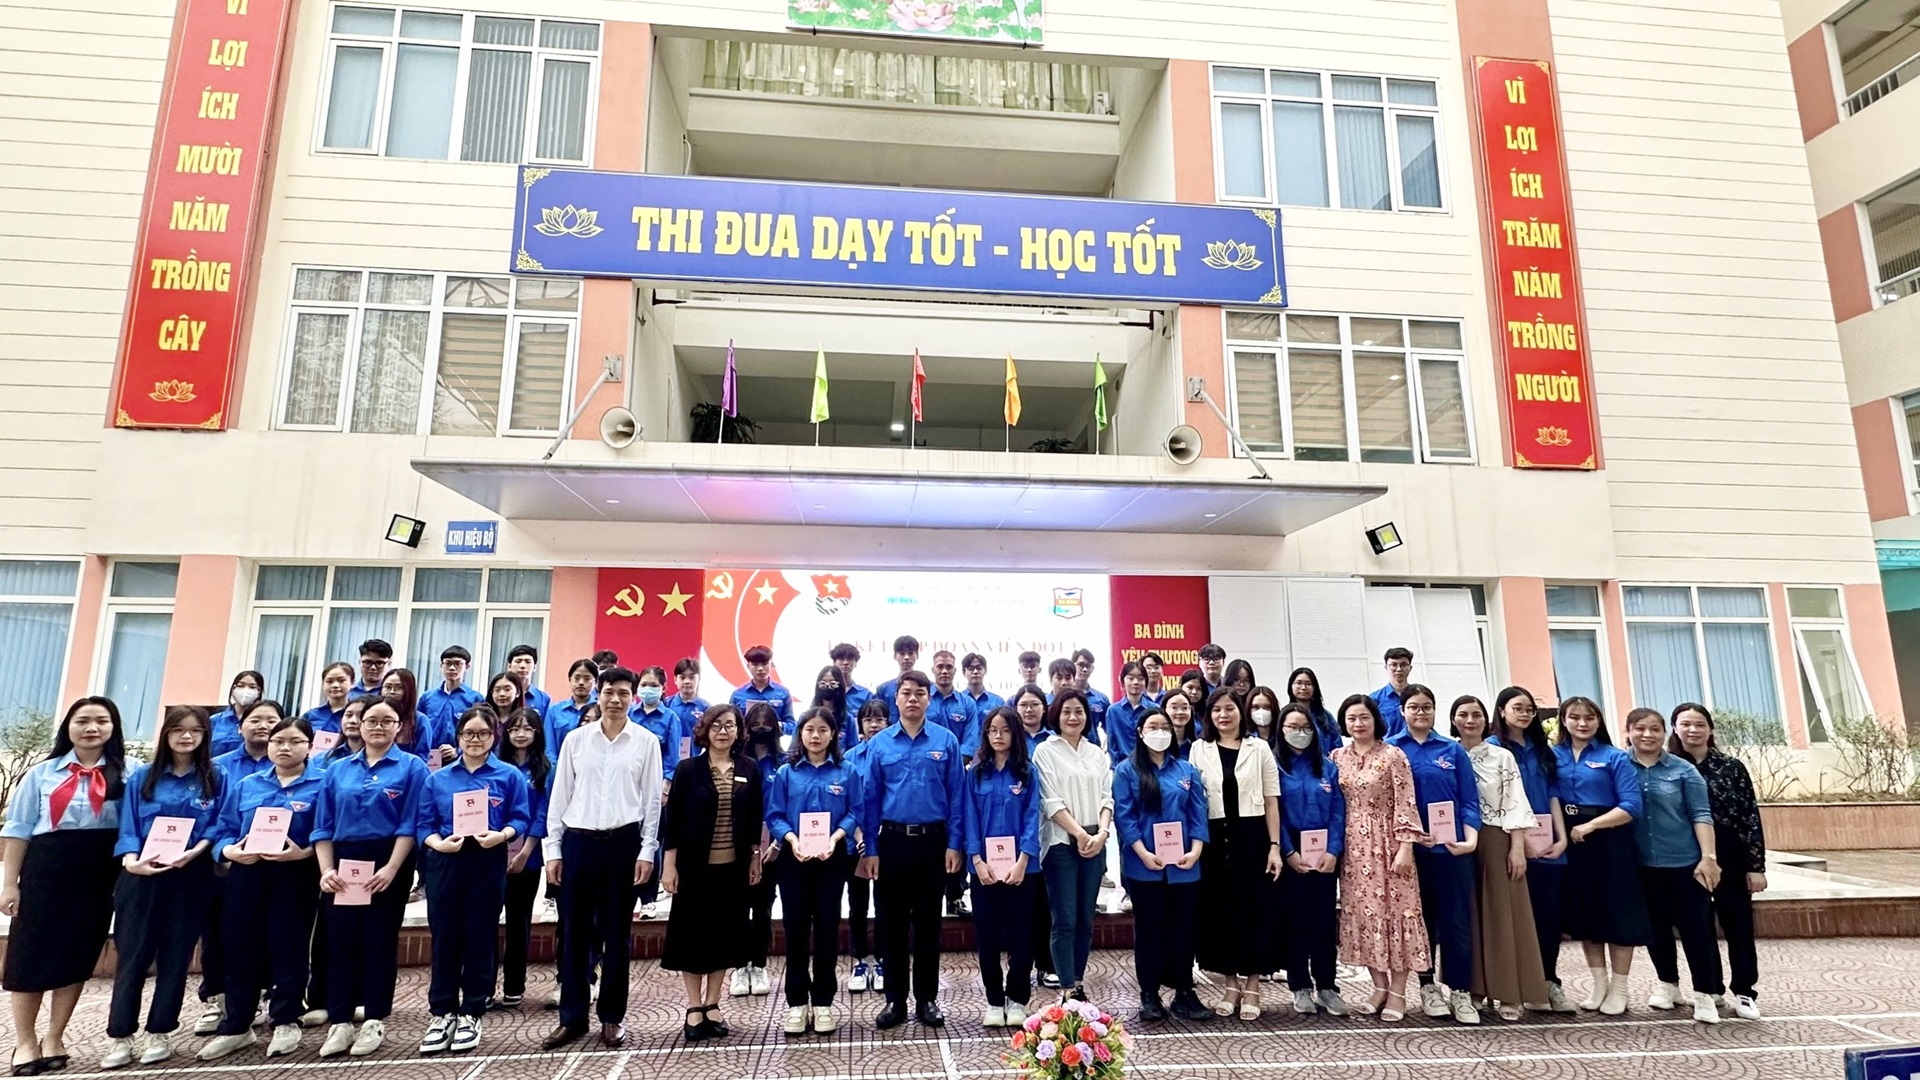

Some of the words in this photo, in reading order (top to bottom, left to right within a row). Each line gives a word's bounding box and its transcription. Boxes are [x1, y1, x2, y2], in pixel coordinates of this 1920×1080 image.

[208, 39, 248, 70] LỢI
[198, 86, 239, 119] ÍCH
[1505, 75, 1525, 103] VÌ
[1505, 126, 1537, 153] LỢI
[176, 142, 242, 175] MƯỜI
[1511, 168, 1543, 198] ÍCH
[170, 196, 229, 232] NĂM
[632, 207, 703, 253] THI
[715, 211, 799, 257] ĐUA
[812, 217, 893, 269] DẠY
[905, 208, 982, 266] TỐT
[994, 246, 1008, 255] -
[1021, 228, 1095, 278] HỌC
[1107, 218, 1181, 275] TỐT
[1503, 218, 1561, 248] TRĂM
[152, 249, 231, 291] TRỒNG
[1514, 267, 1561, 298] NĂM
[159, 315, 206, 350] CÂY
[1509, 313, 1576, 350] TRỒNG
[1516, 372, 1580, 402] NGƯỜI
[448, 530, 464, 546] KHU
[1134, 623, 1151, 639] BA
[1154, 621, 1184, 639] ĐÌNH
